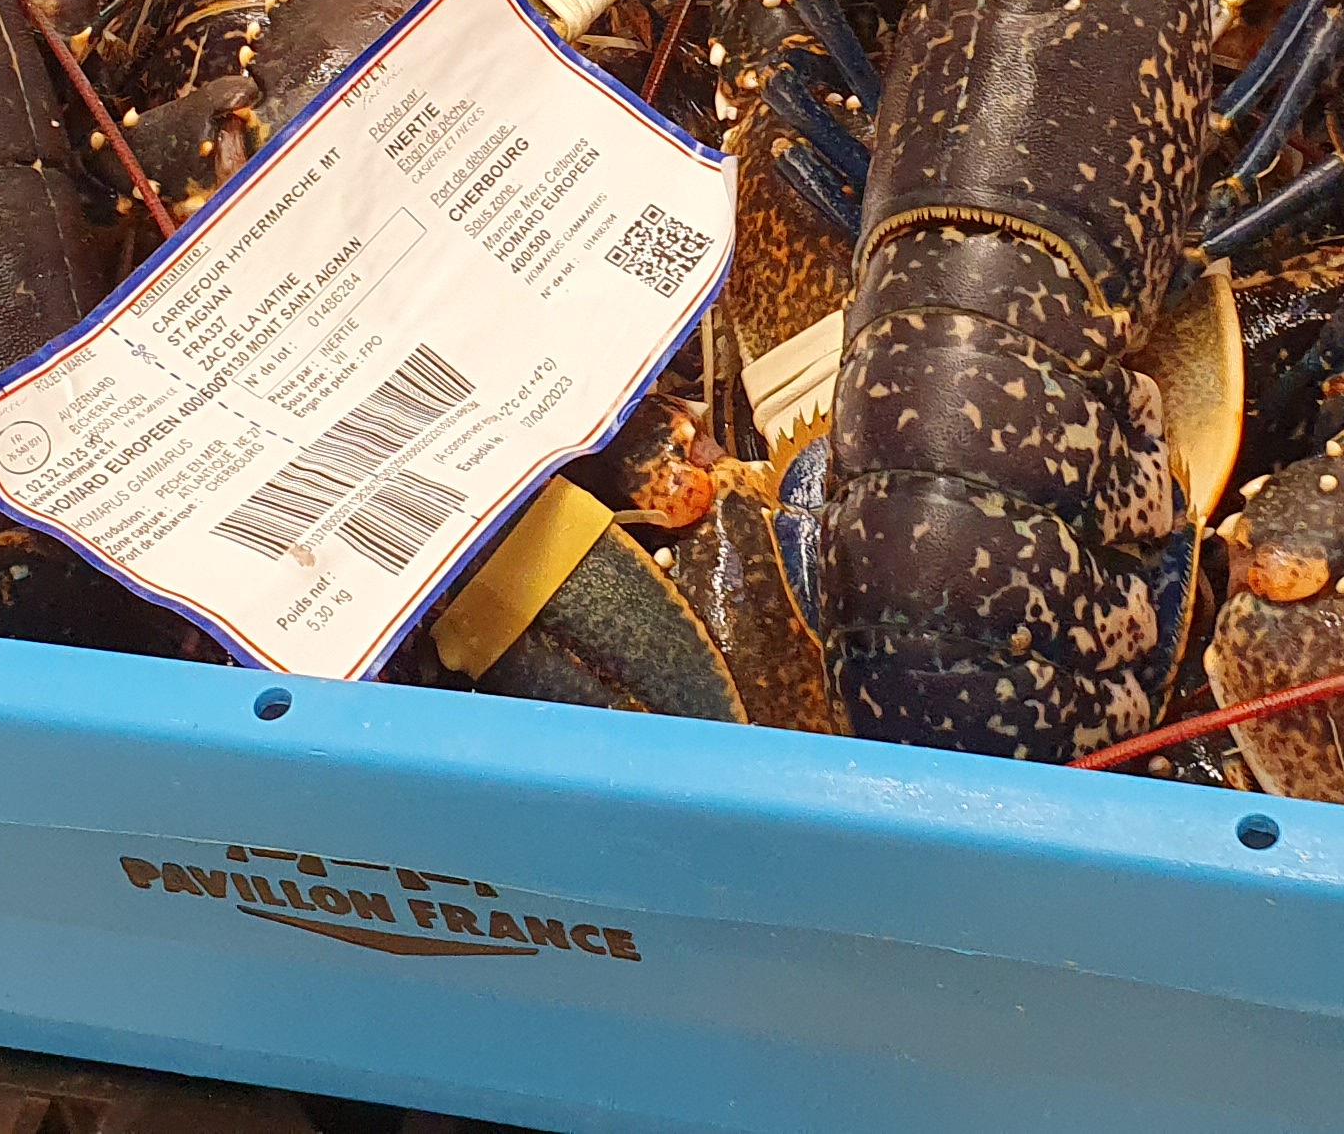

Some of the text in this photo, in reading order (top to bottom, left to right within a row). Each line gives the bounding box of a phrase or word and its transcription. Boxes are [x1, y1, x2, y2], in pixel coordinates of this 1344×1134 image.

[338, 58, 388, 108] ROUEN
[399, 88, 422, 111] par
[384, 101, 441, 160] INERTIE
[396, 142, 430, 174] Engin
[425, 129, 442, 146] de
[411, 147, 447, 185] CASIERS
[444, 135, 457, 149] ET
[429, 125, 511, 206] Port de débarque
[448, 137, 529, 222] CHERBOURG
[481, 137, 589, 251] Manche Mers Celtiques
[464, 184, 516, 237] Sous zone
[493, 147, 600, 263] HOMARD EUROPEEN
[152, 146, 341, 334] CARREFOUR HYPERMARCHE MT
[510, 229, 552, 274] 400/500
[524, 192, 608, 285] HOMARUS GAMMARUS
[127, 244, 202, 316] Destinataire
[245, 317, 283, 354] MONT
[280, 282, 316, 321] SAINT
[315, 236, 362, 287] AIGNAN
[552, 275, 564, 287] de
[560, 262, 575, 276] lot
[167, 284, 233, 347] ST AIGNAN
[182, 315, 228, 359] FRA337
[198, 272, 301, 372] ZAC DE LA VATINE
[243, 272, 362, 389] N° de lot 01486284
[33, 347, 97, 393] ROUEN MAREE
[281, 350, 349, 411] Sous zone VII
[293, 397, 322, 419] Engin
[319, 385, 333, 398] de
[358, 335, 383, 358] FPO
[295, 365, 313, 384] par
[318, 317, 360, 358] INERTIE
[57, 407, 73, 422] AV
[69, 376, 116, 413] BERNARD
[68, 393, 118, 435] BICHERAY
[110, 393, 147, 421] ROUEN
[517, 384, 532, 401] et
[25, 479, 46, 493] 02
[41, 468, 62, 483] 32
[56, 457, 75, 470] 10
[70, 447, 89, 462] 25
[43, 473, 109, 519] HOMARD
[104, 414, 182, 475] EUROPEEN
[71, 438, 194, 532] HOMARUS GAMMARUS
[91, 439, 227, 546] Production PECHE EN MER
[105, 536, 133, 556] Zone
[130, 511, 167, 539] capture
[177, 449, 236, 500] ATLANTIQUE
[233, 435, 252, 450] NE
[116, 442, 265, 565] Port de débarque CHERBOURG
[276, 575, 331, 631] Poids net
[306, 588, 353, 632] 5,30 kg
[120, 855, 643, 962] PAVILLON FRANCE
